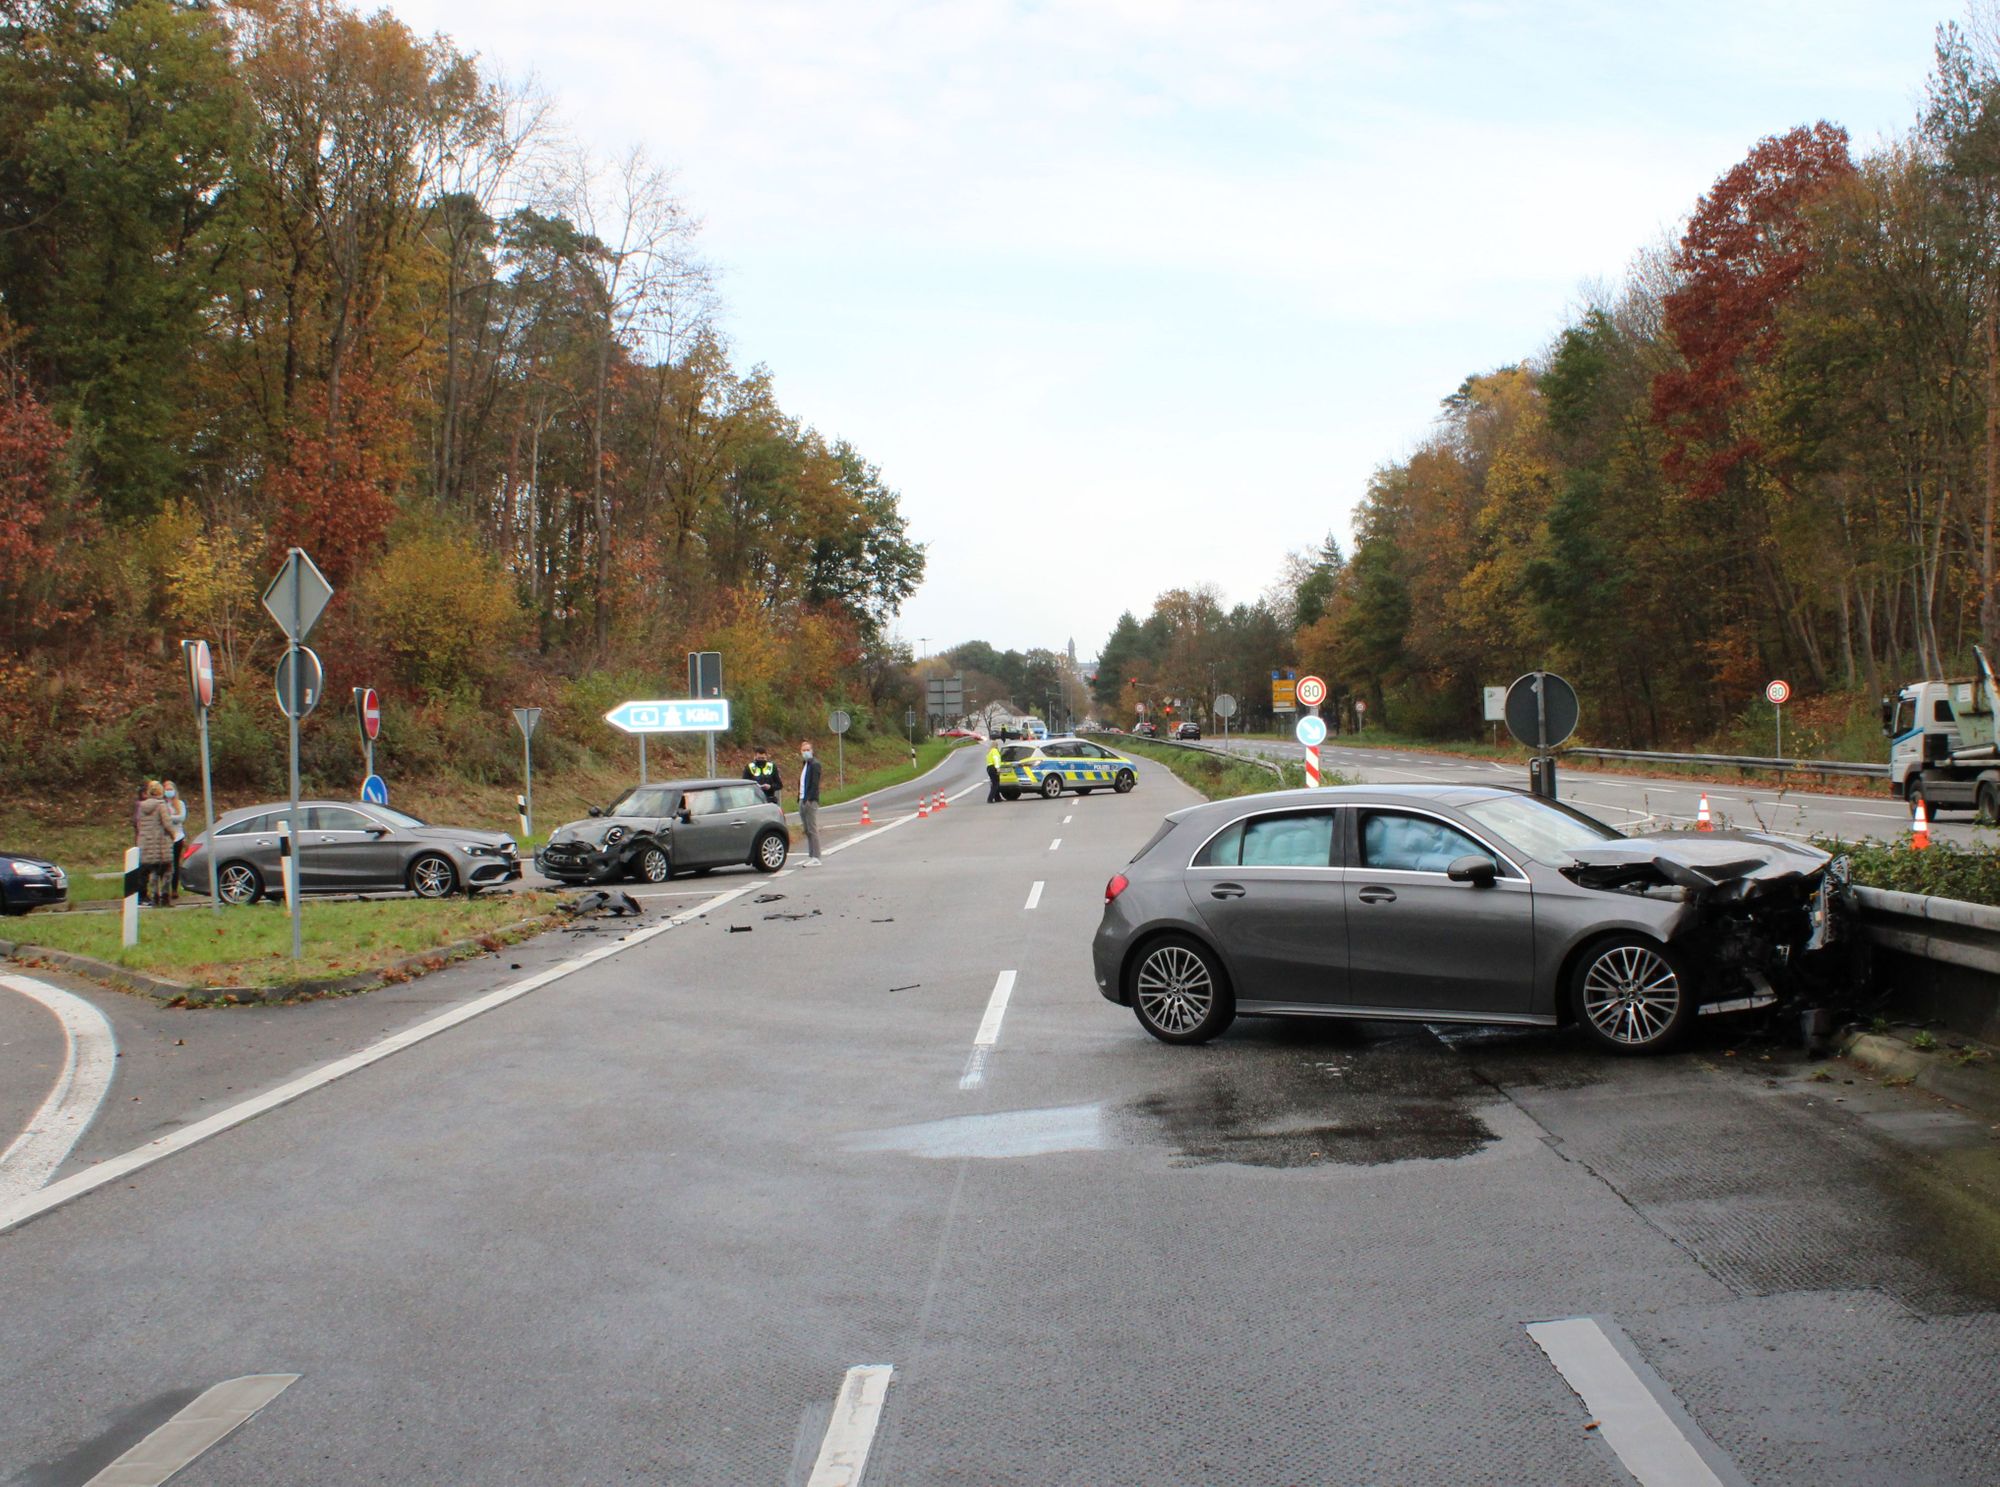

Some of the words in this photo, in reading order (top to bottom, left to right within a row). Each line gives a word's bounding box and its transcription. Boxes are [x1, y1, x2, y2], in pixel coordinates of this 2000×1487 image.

[1303, 684, 1320, 698] 80
[1772, 686, 1784, 697] 80
[686, 708, 720, 722] Köln
